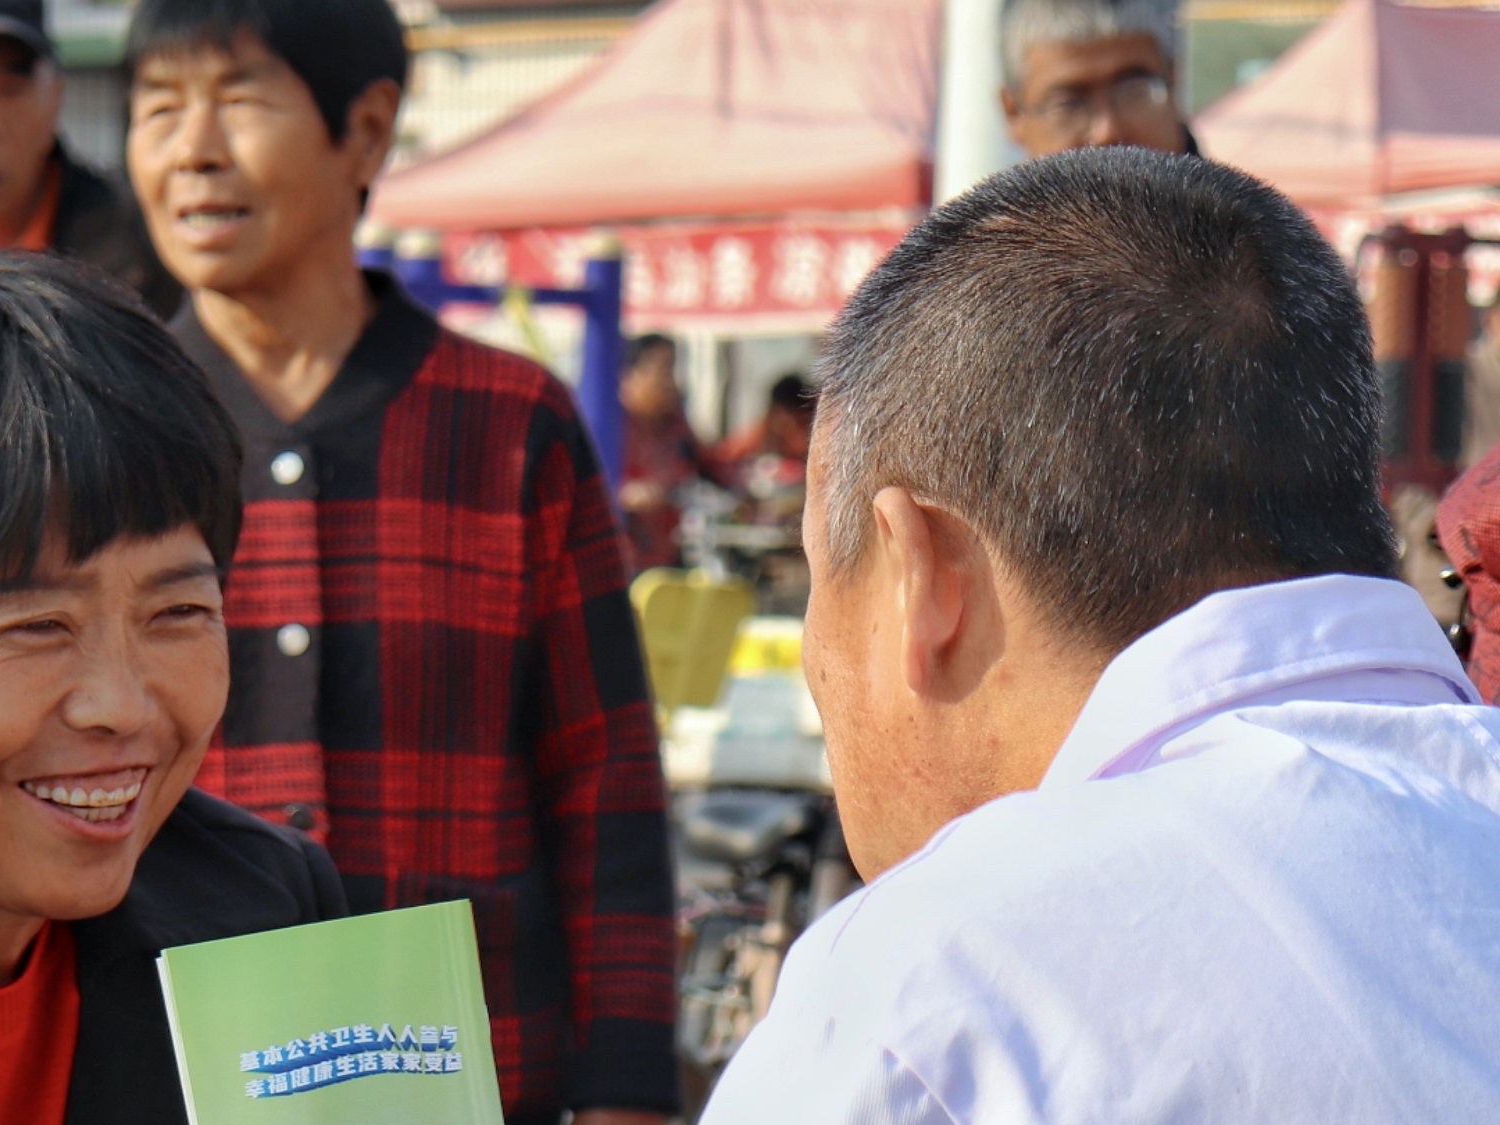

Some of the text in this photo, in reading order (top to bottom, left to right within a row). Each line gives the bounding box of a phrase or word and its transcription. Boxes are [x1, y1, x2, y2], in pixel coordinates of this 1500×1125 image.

[241, 1023, 458, 1071] 基本公共卫生人人参与
[245, 1052, 463, 1098] 幸福健康生活家家受益
